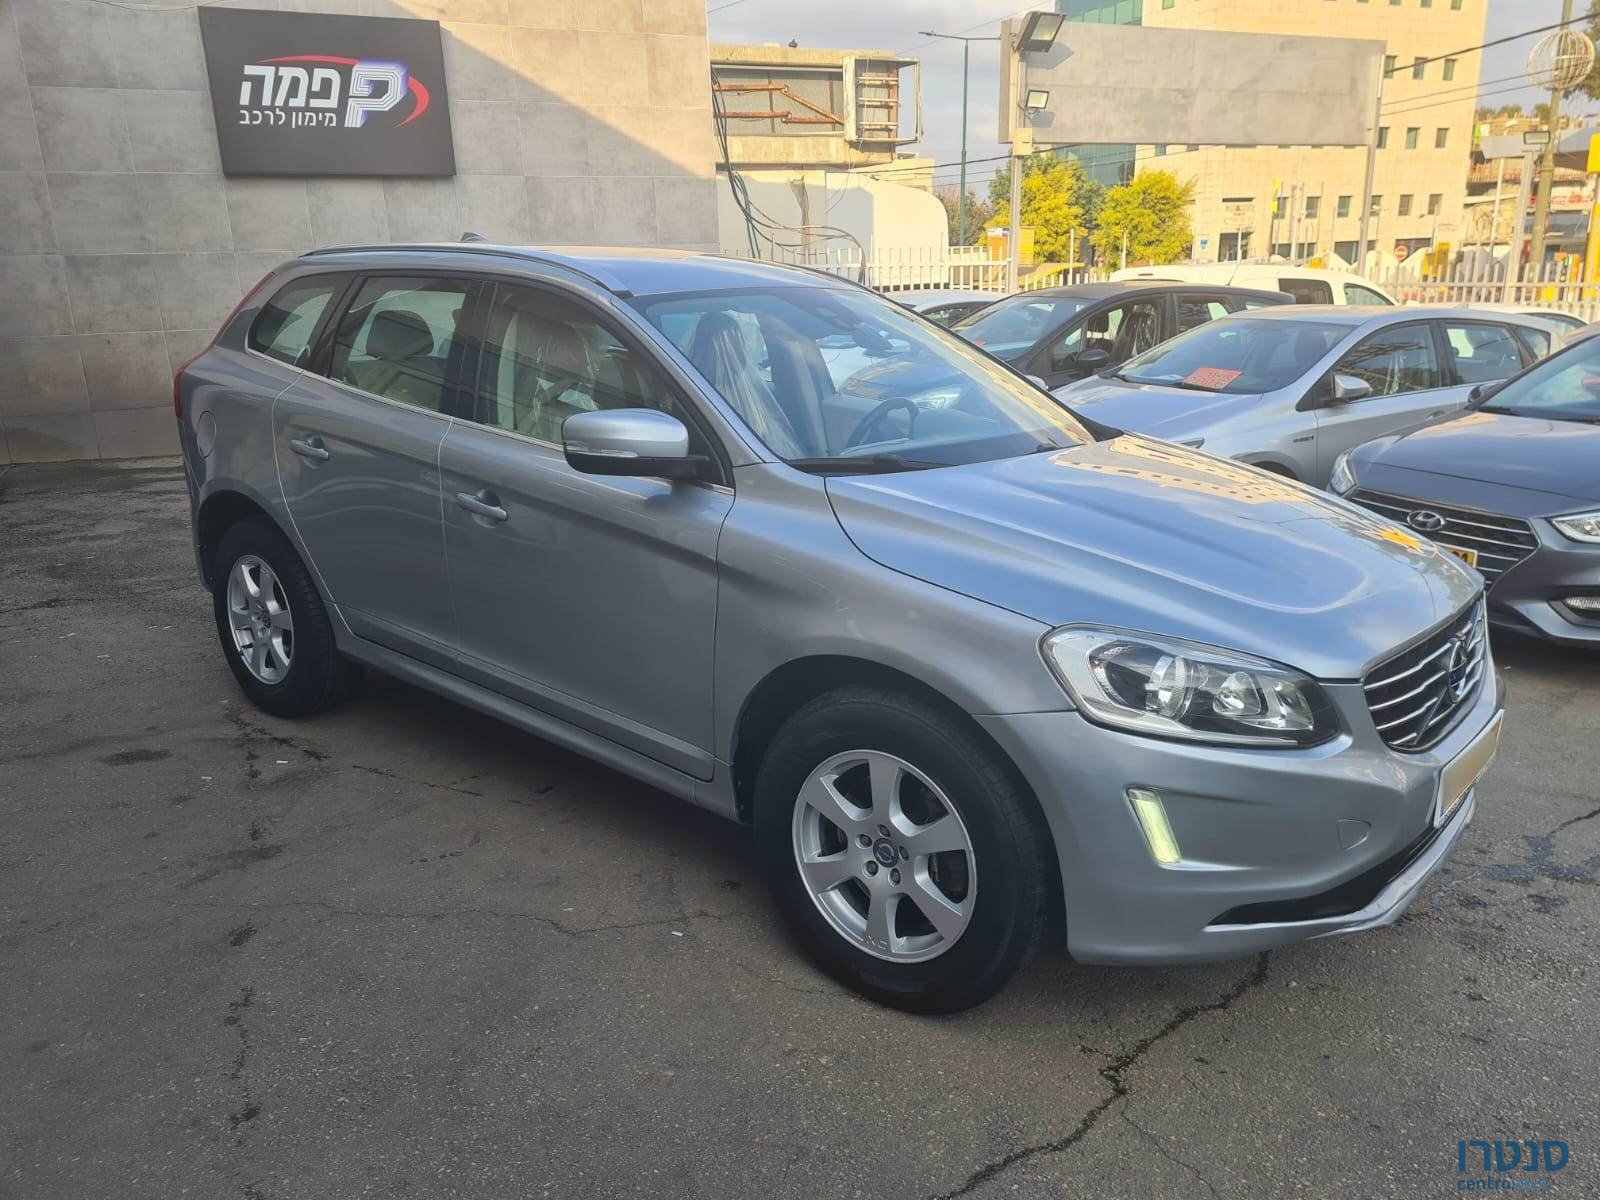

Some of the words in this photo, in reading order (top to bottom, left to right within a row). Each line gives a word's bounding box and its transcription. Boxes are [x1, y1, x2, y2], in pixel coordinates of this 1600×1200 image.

[239, 64, 341, 109] פמה
[239, 108, 286, 126] לרכב
[291, 110, 337, 129] מימון
